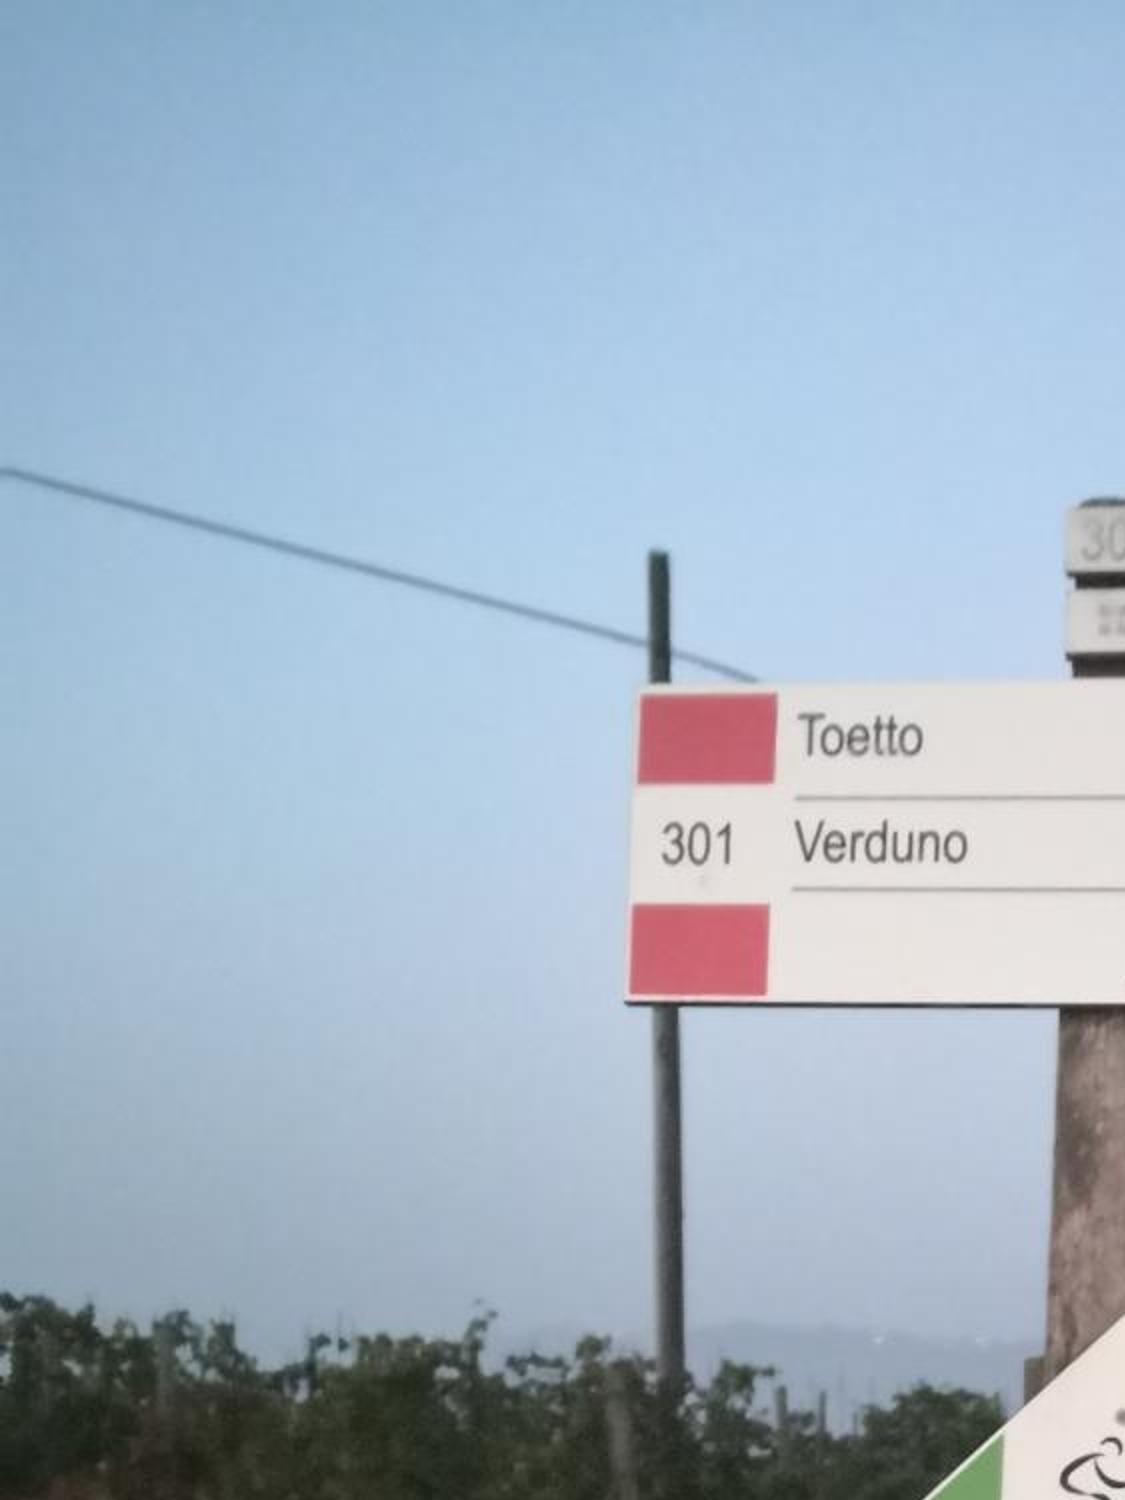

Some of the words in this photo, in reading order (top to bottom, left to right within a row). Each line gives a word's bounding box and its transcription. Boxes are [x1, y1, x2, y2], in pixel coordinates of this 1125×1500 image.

[797, 712, 924, 758] Toetto
[661, 821, 732, 867] 301
[794, 819, 969, 865] Verduno
